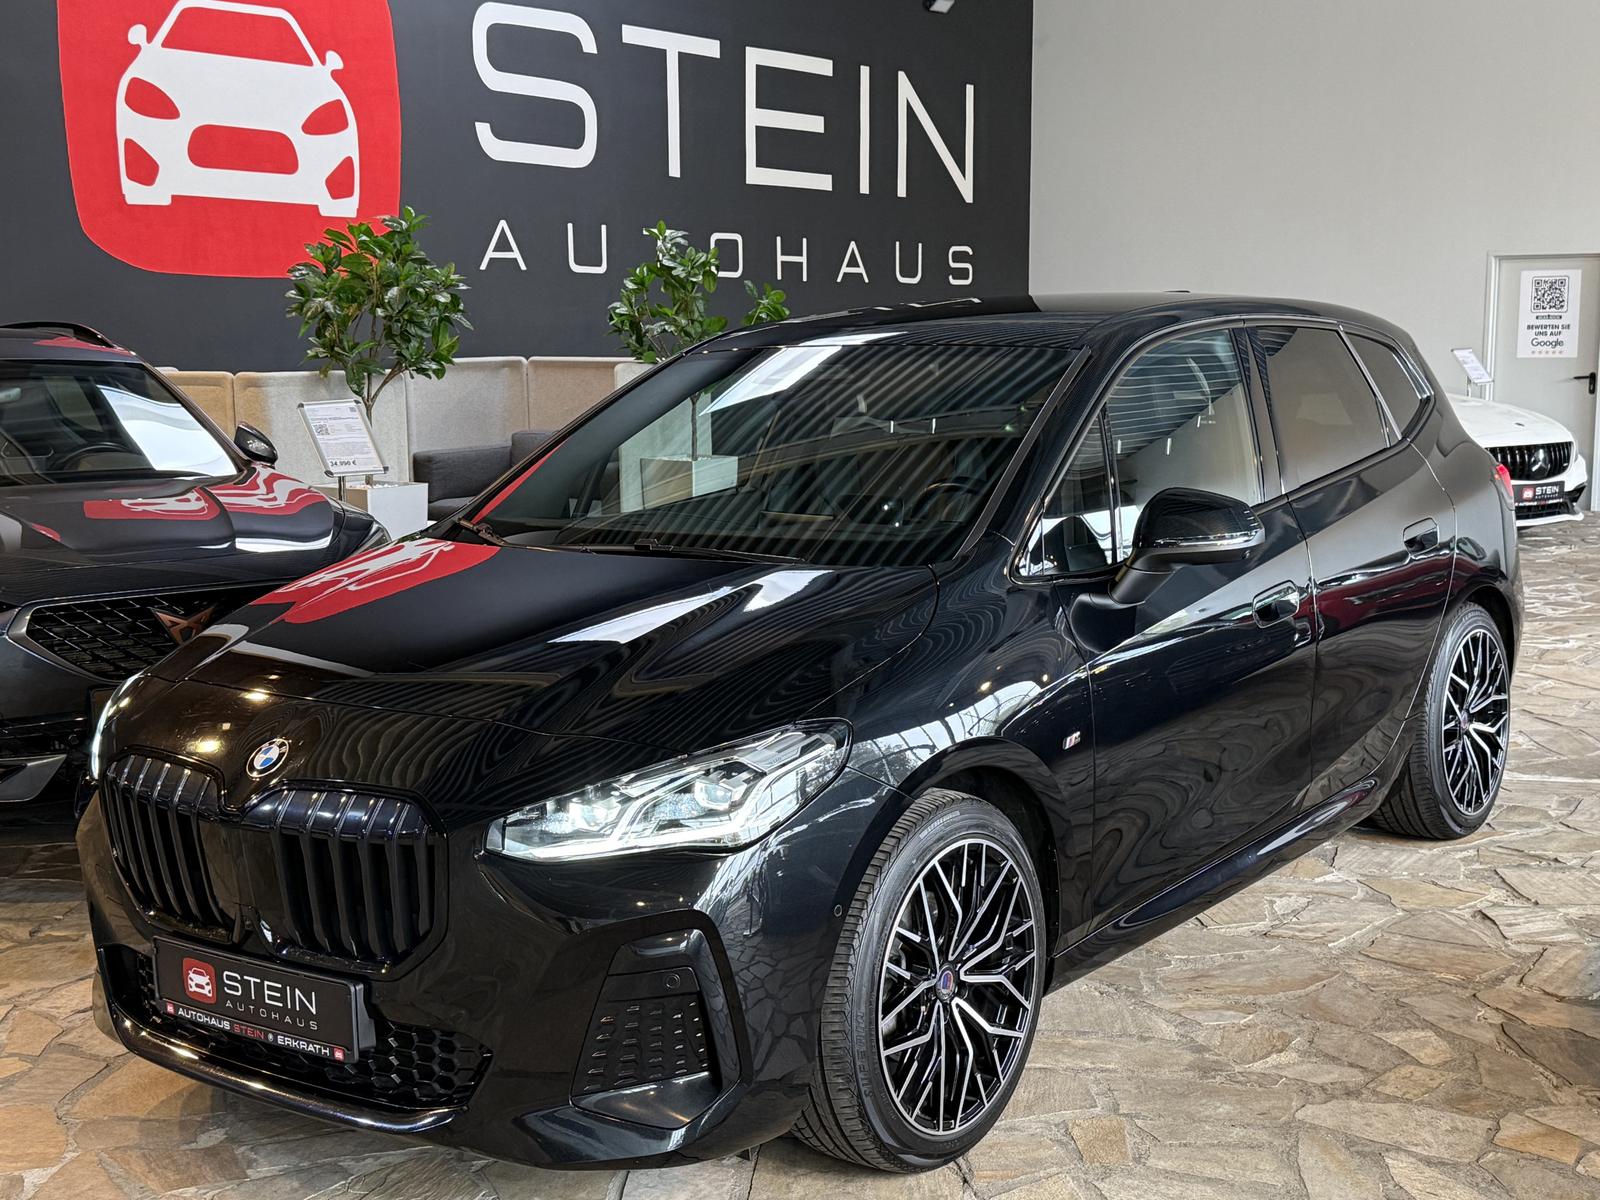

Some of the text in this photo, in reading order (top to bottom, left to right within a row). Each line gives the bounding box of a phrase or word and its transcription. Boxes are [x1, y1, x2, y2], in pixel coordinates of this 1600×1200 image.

[472, 2, 973, 203] STEIN
[1531, 337, 1564, 349] Google
[1535, 485, 1560, 495] STEIN
[222, 971, 317, 1015] STEIN
[177, 1007, 330, 1057] AUTOHAUS STEIN ERKRATH
[225, 999, 319, 1031] AUTOHAUS
